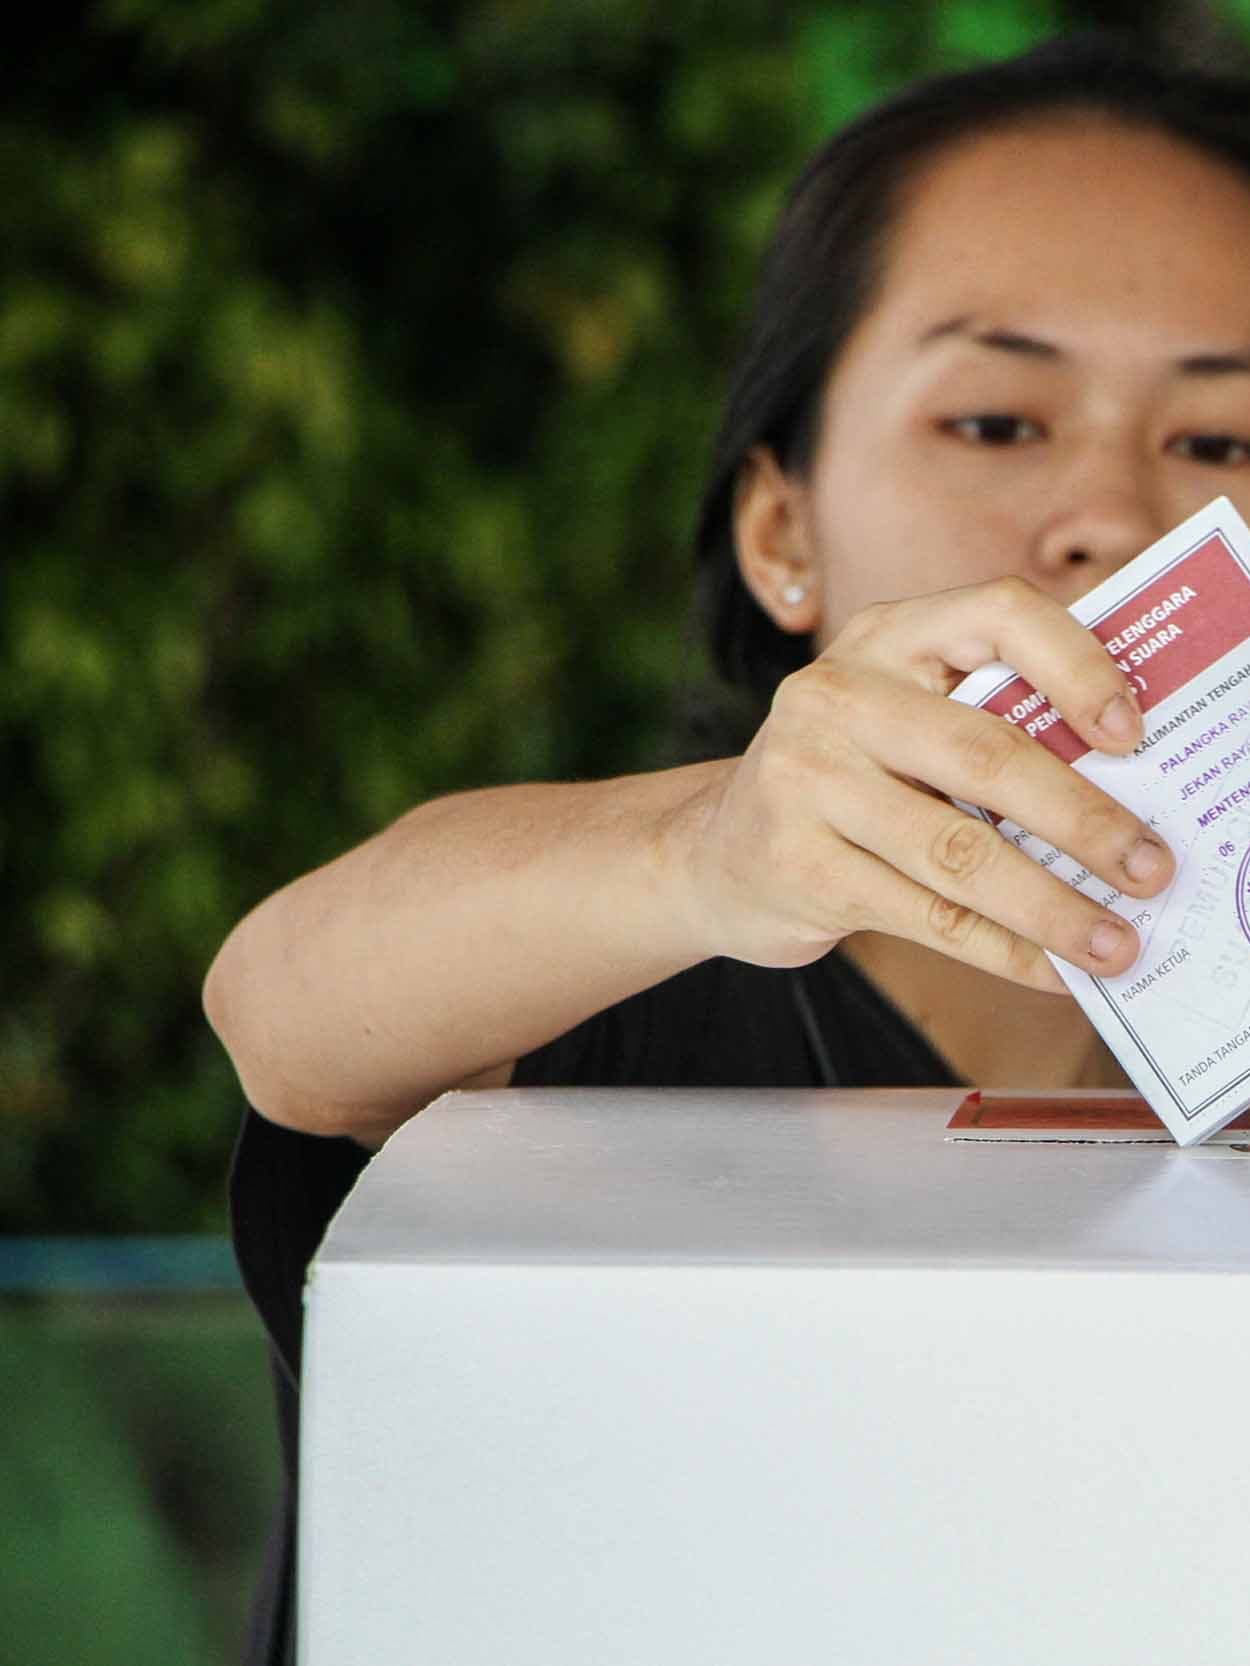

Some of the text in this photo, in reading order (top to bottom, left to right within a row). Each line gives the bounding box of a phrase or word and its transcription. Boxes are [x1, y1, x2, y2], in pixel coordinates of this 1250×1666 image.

[1105, 583, 1198, 656] ELENGGARA
[1129, 623, 1184, 667] SUARA
[1133, 698, 1208, 757] KALIMANTAN
[1158, 720, 1230, 775] PALANGKA
[1180, 764, 1222, 802] JEKAN
[1217, 839, 1236, 857] 06
[1131, 909, 1154, 929] TPS
[1120, 972, 1157, 1004] NAMA
[1153, 946, 1193, 982] KETUA
[1177, 1054, 1219, 1090] TANDA
